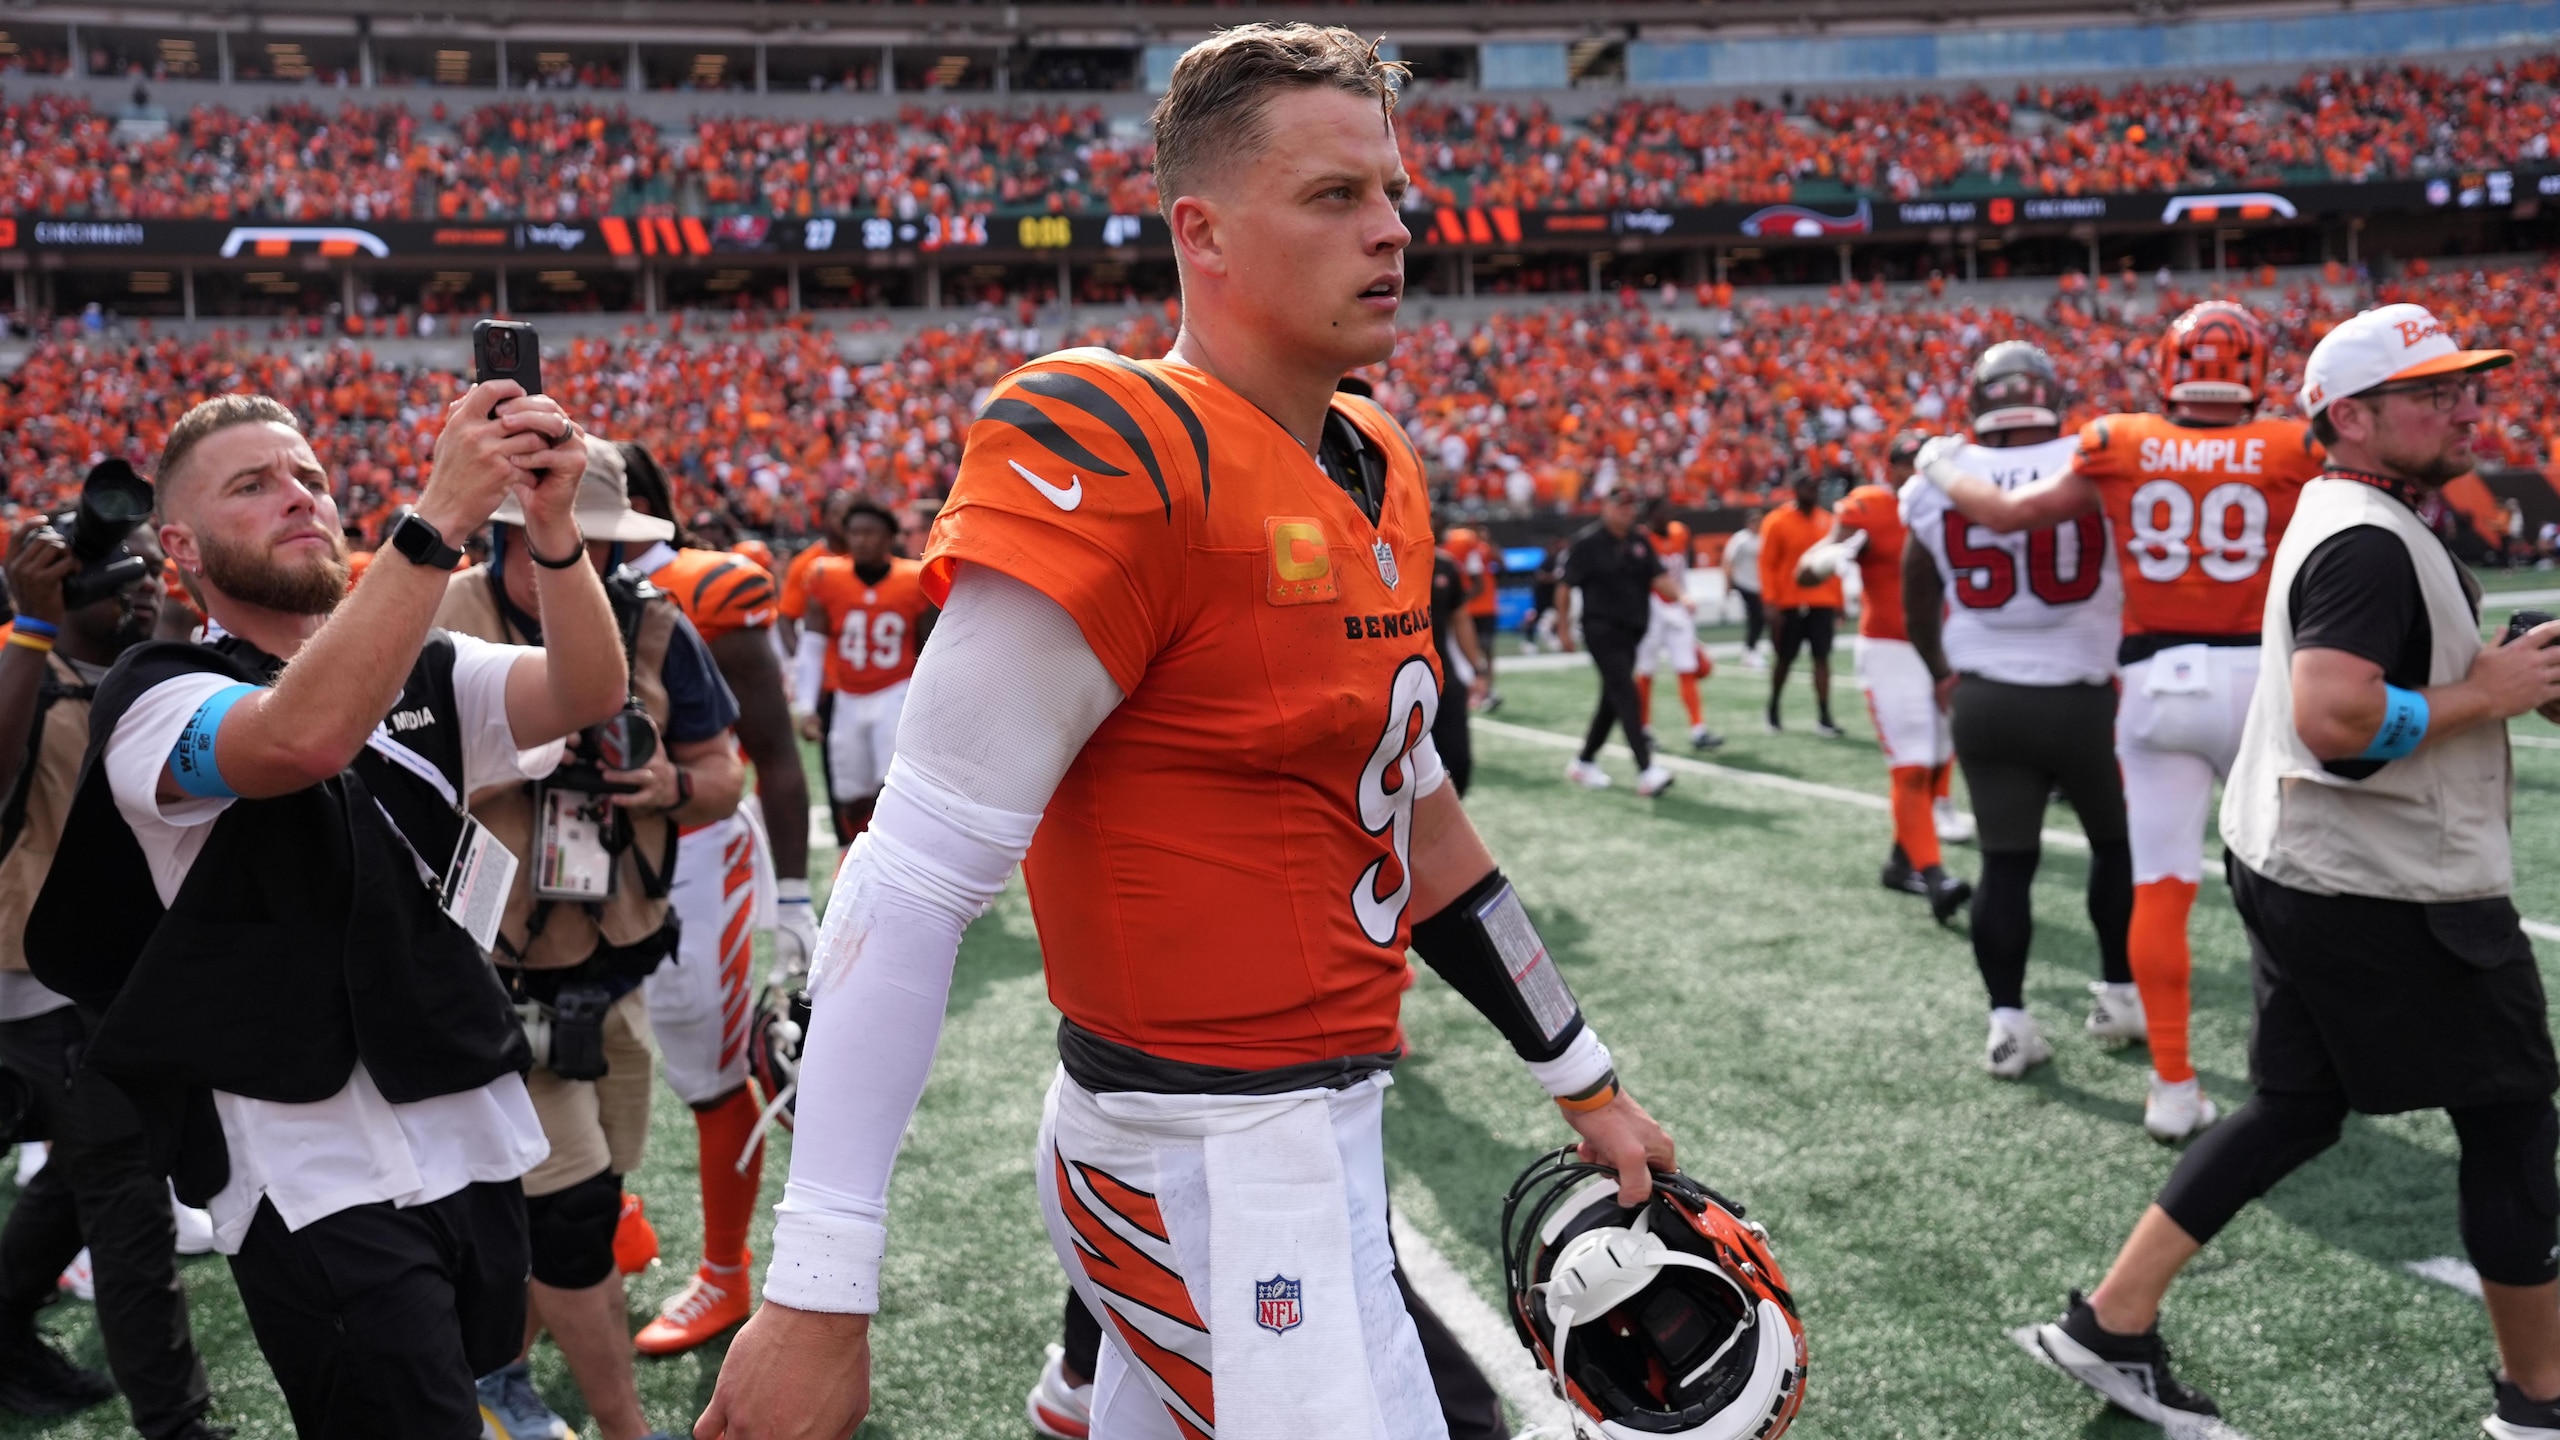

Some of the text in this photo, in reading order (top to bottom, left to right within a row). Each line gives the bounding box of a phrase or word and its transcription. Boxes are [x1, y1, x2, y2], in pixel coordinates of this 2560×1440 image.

[804, 218, 836, 249] 27
[2140, 437, 2267, 474] SAMPLE
[1274, 523, 1330, 582] C
[1944, 508, 2105, 609] 50
[2127, 479, 2269, 582] 89
[838, 610, 907, 670] 49
[392, 706, 436, 732] MDIA
[1351, 655, 1441, 948] 9
[1260, 1300, 1299, 1328] NFL
